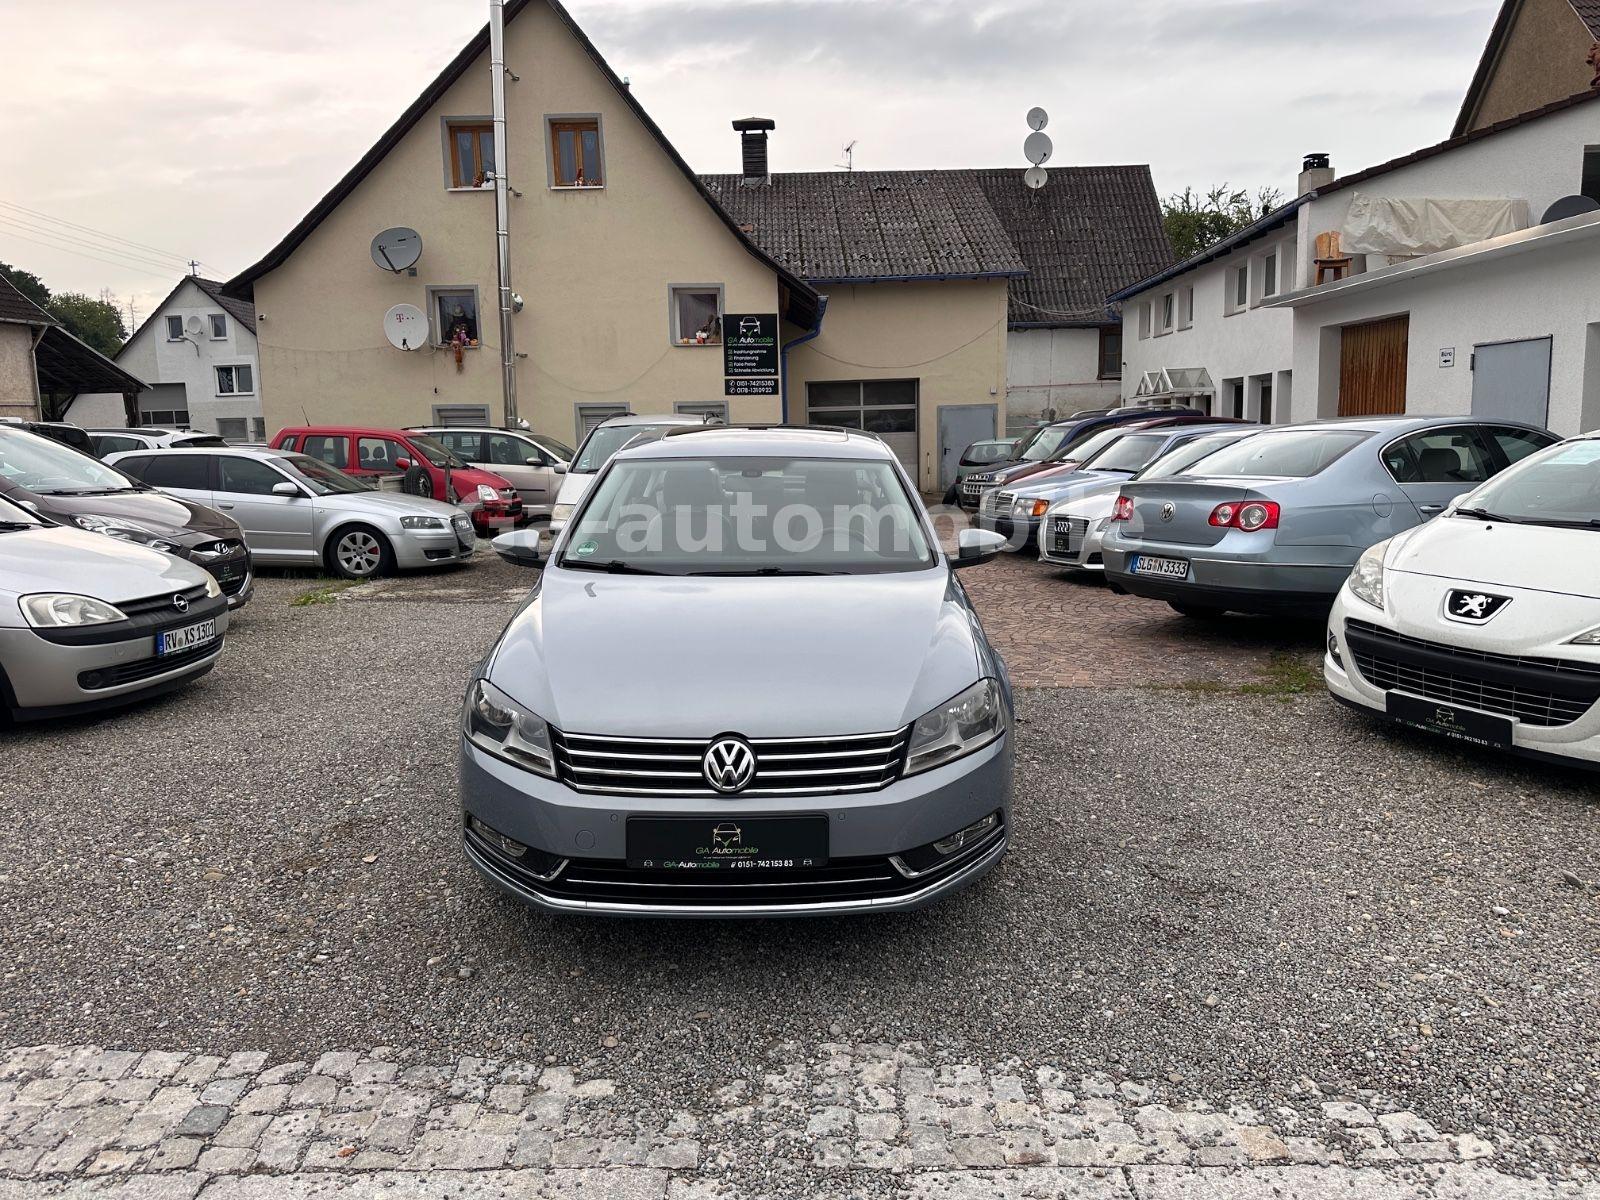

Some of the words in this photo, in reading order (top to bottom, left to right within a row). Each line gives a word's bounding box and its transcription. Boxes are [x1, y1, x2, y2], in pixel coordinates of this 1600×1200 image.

[1136, 557, 1154, 571] SLG
[1156, 559, 1165, 572] N
[1164, 561, 1187, 575] 3333
[164, 631, 178, 651] RV
[183, 627, 195, 646] XS
[196, 621, 214, 641] 1301
[695, 847, 710, 855] GA
[712, 846, 759, 855] Automobile
